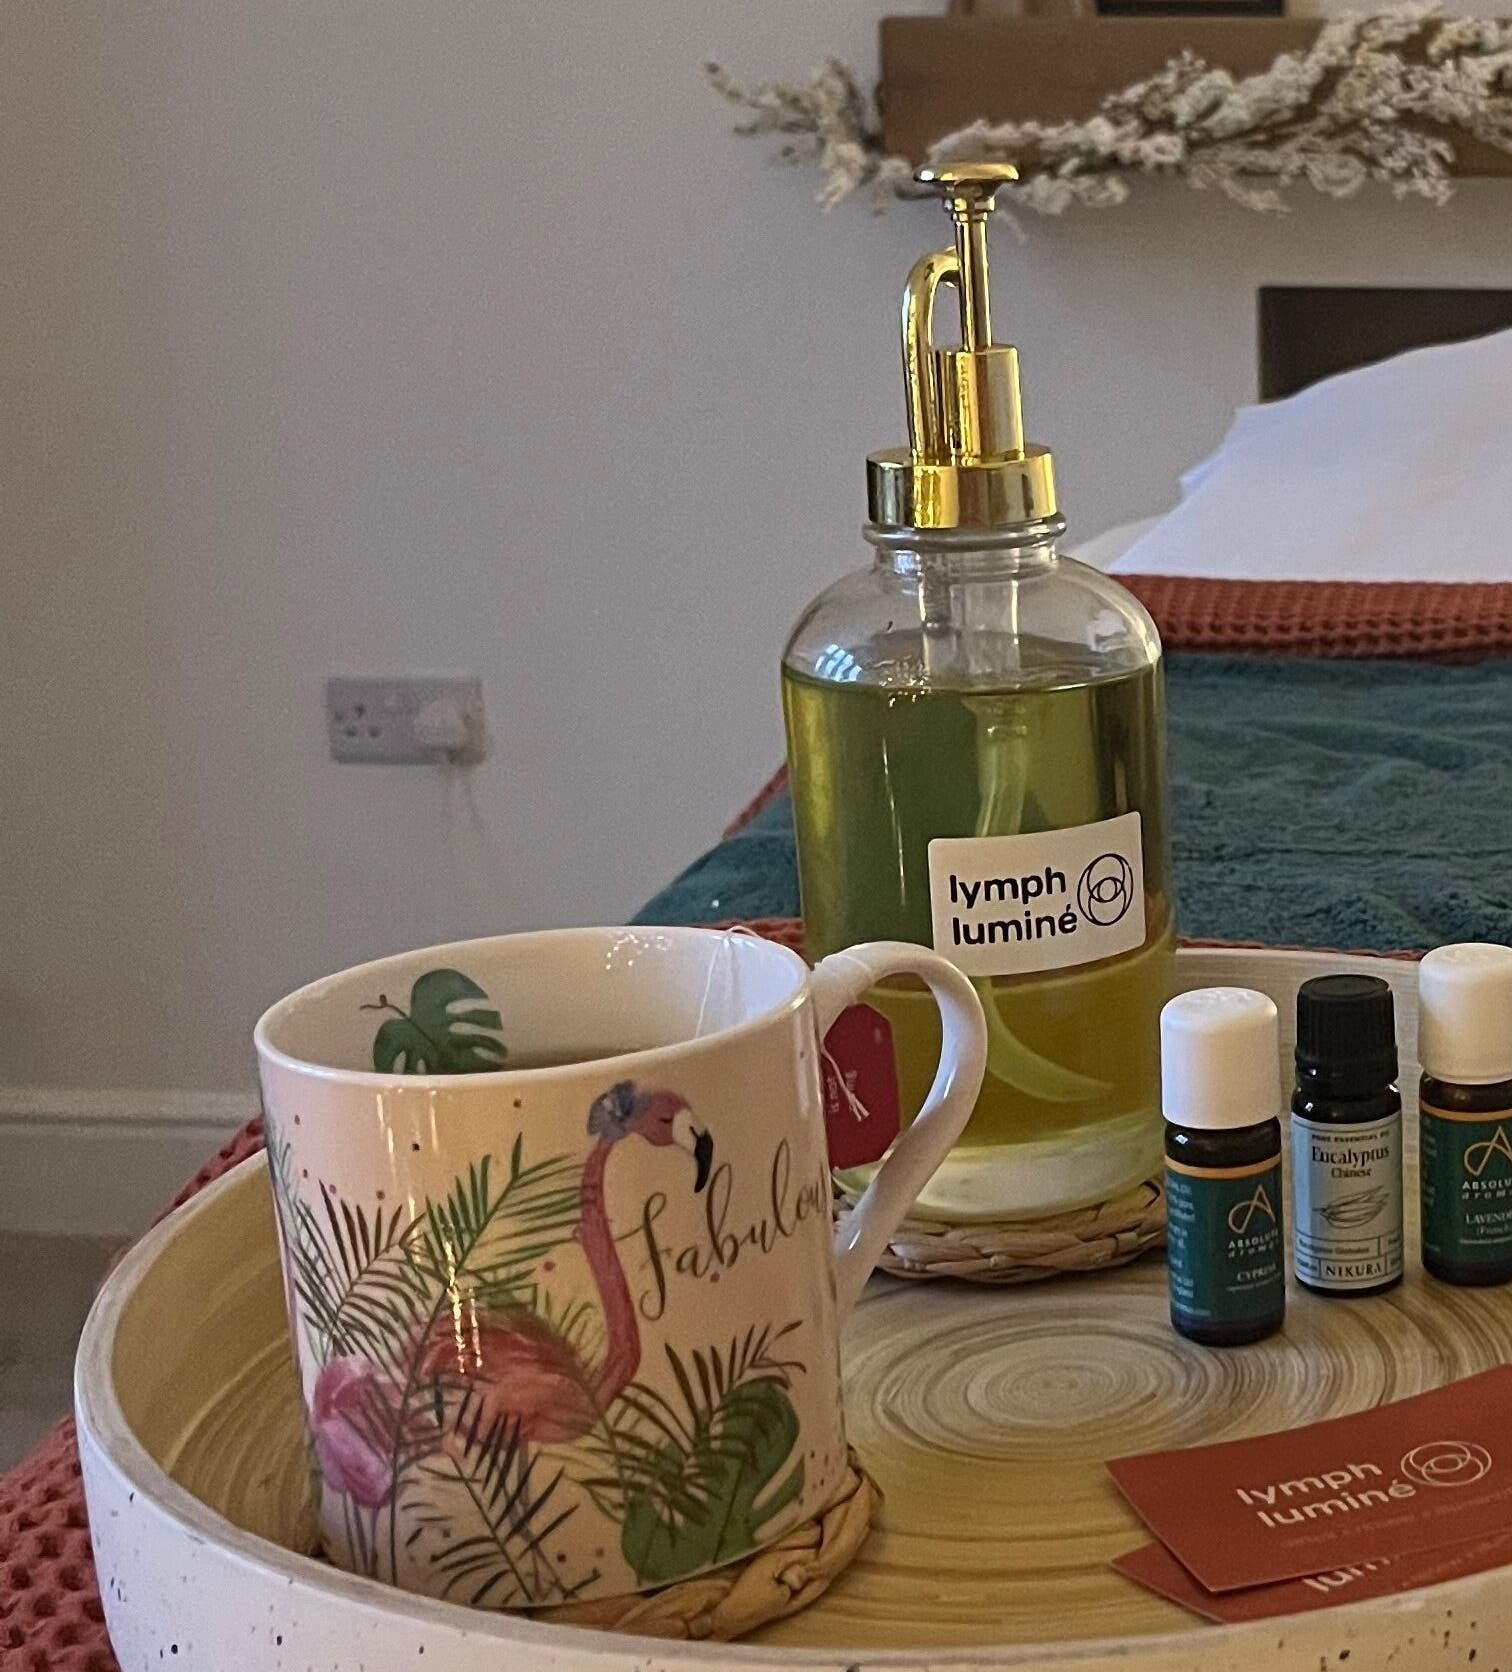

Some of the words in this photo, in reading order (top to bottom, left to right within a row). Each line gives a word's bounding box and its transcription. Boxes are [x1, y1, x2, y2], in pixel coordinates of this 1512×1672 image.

[950, 867, 1066, 909] lymph
[953, 904, 1077, 945] luminé
[1312, 1145, 1390, 1169] Eucalyptus
[1331, 1167, 1371, 1179] Chinese
[1326, 1264, 1382, 1278] NIKURA
[1236, 1464, 1383, 1505] lymph
[1257, 1479, 1416, 1528] luminé
